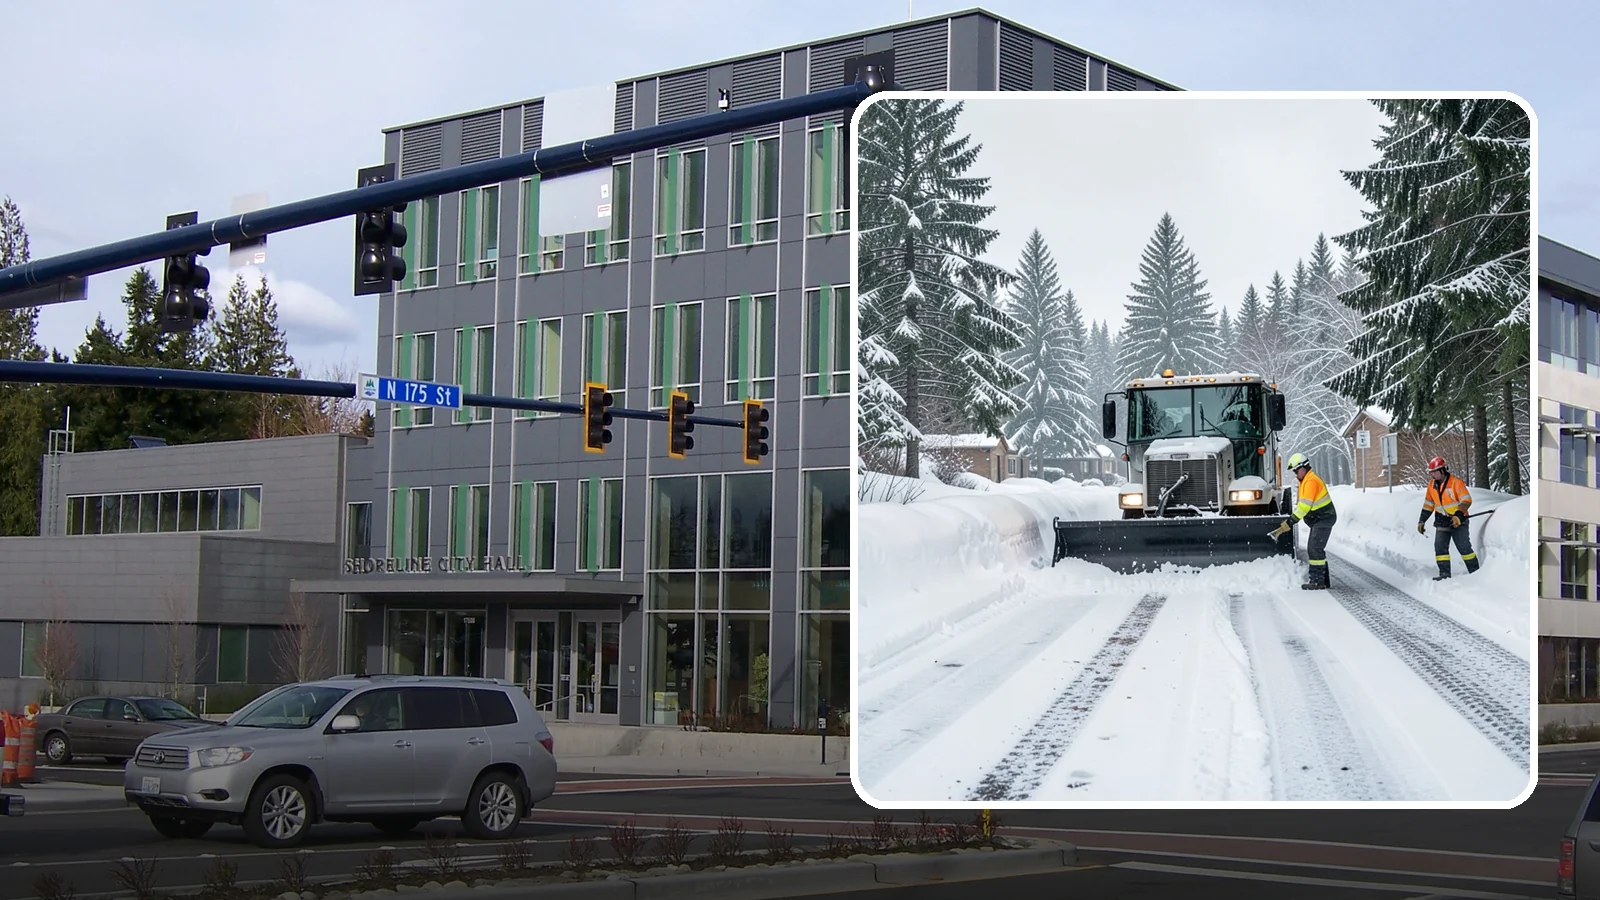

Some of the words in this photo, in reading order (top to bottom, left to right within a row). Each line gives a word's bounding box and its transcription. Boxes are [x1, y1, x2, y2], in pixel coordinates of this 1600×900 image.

[387, 380, 396, 400] N
[405, 383, 428, 403] 175
[436, 386, 451, 406] St
[343, 556, 432, 574] SHORELINE
[438, 556, 476, 572] CITY
[484, 555, 525, 572] HALL
